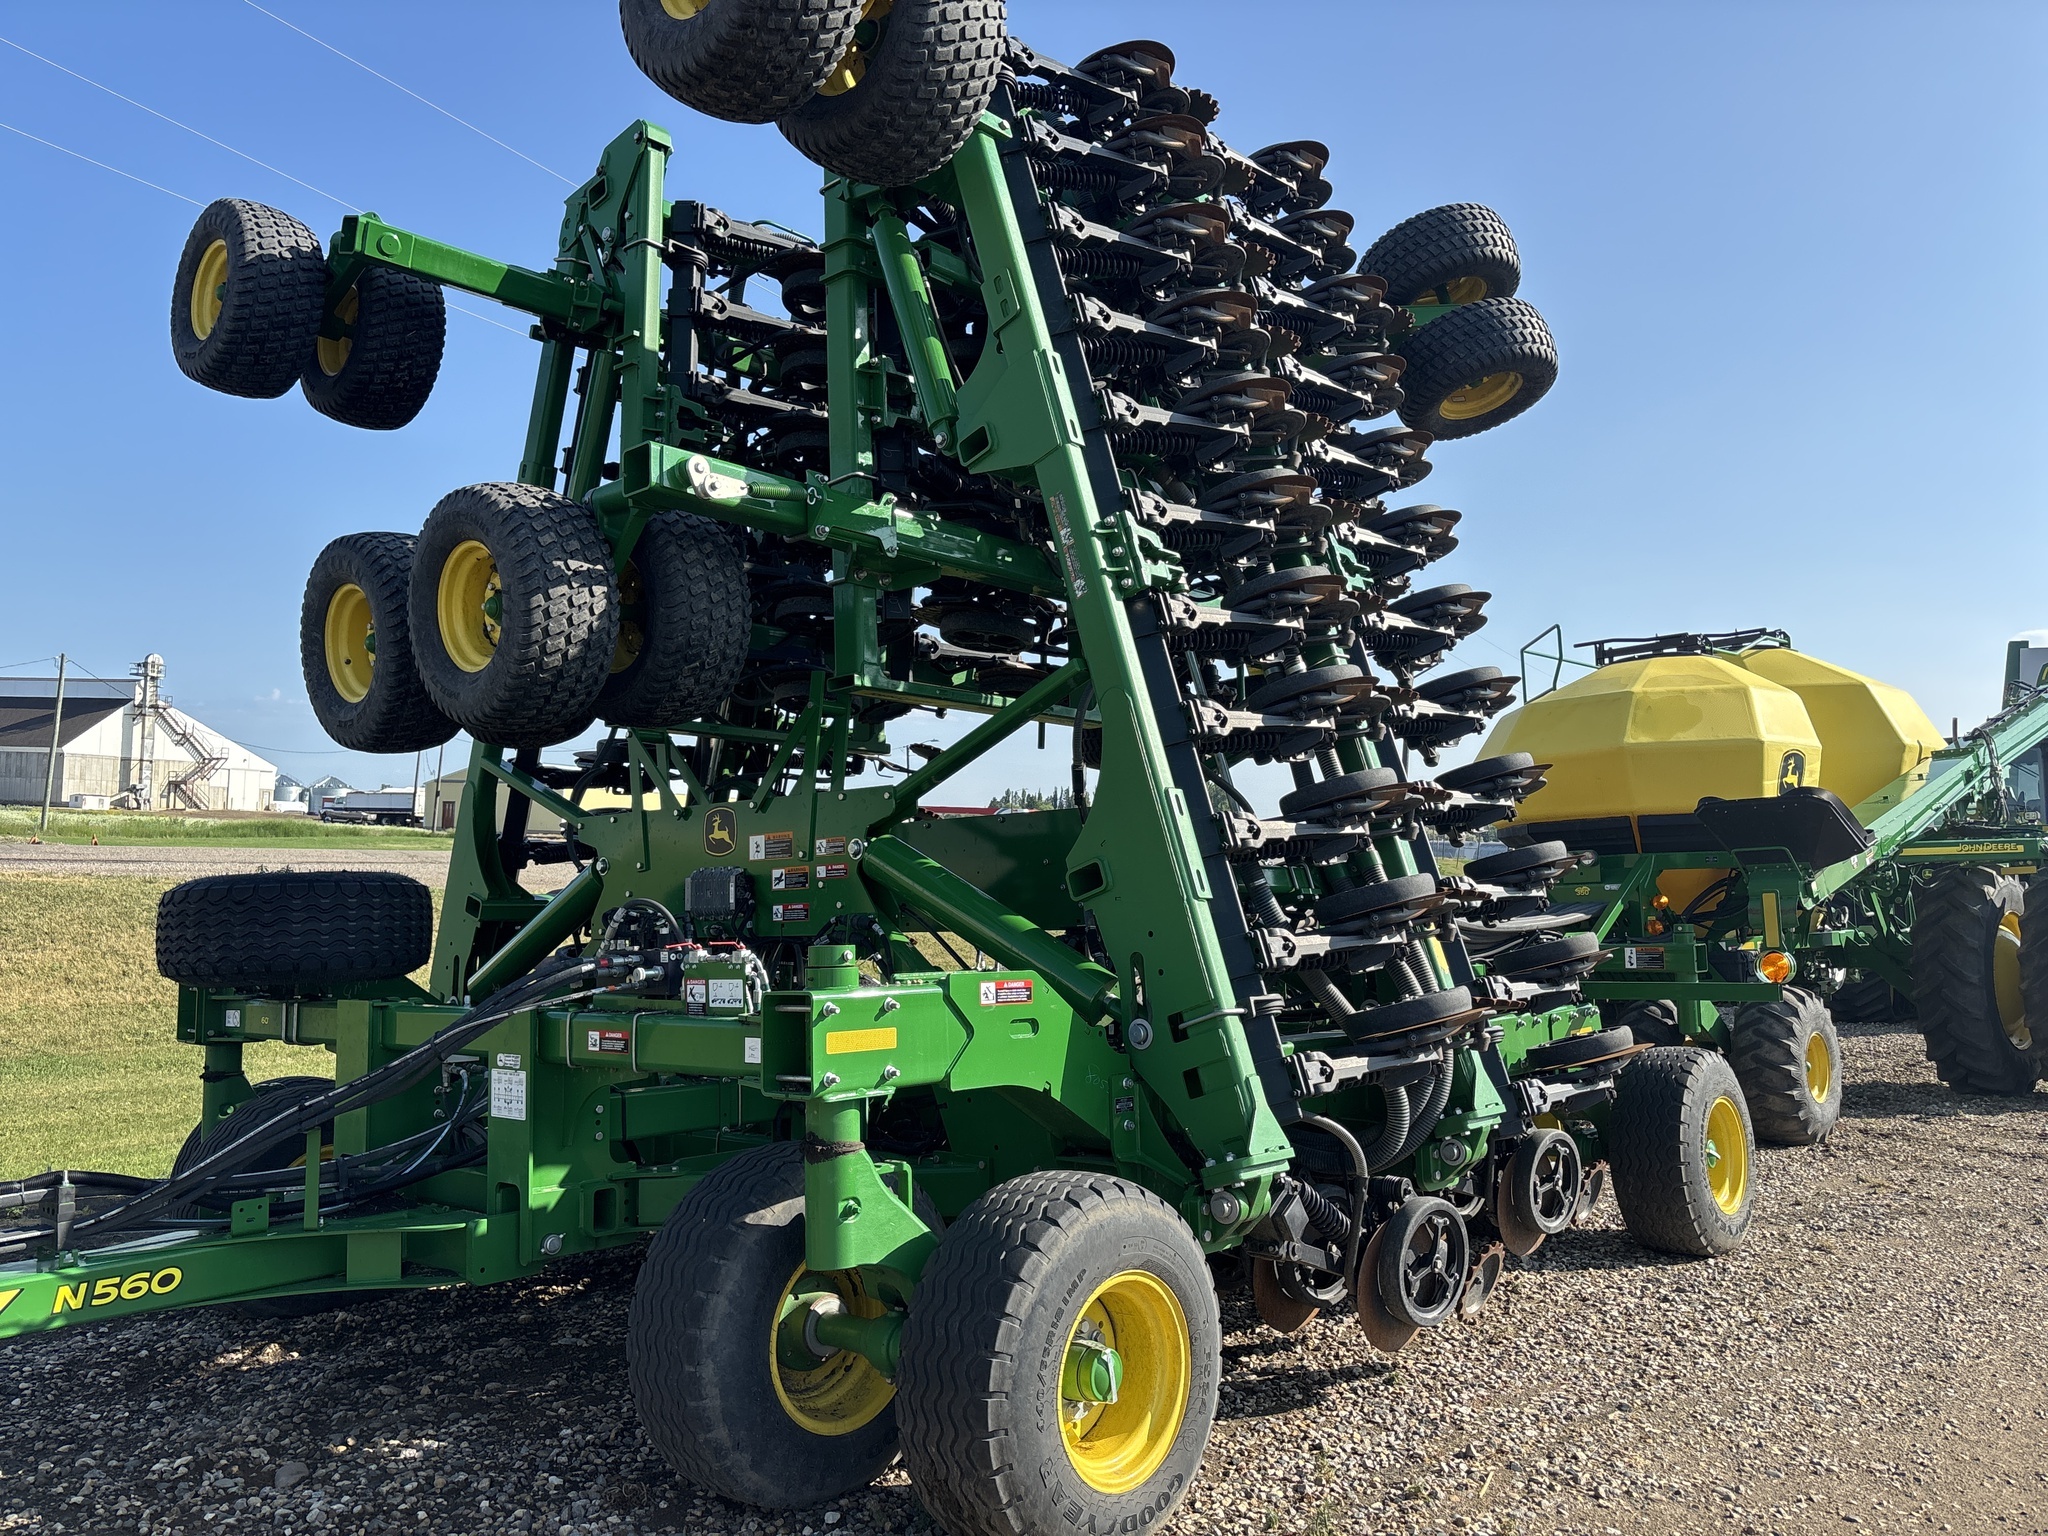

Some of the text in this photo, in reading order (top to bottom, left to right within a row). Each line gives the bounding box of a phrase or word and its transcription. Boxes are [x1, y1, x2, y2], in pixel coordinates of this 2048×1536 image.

[1957, 842, 2018, 853] JOHN DEERE
[1039, 1456, 1184, 1536] GOODYEAR
